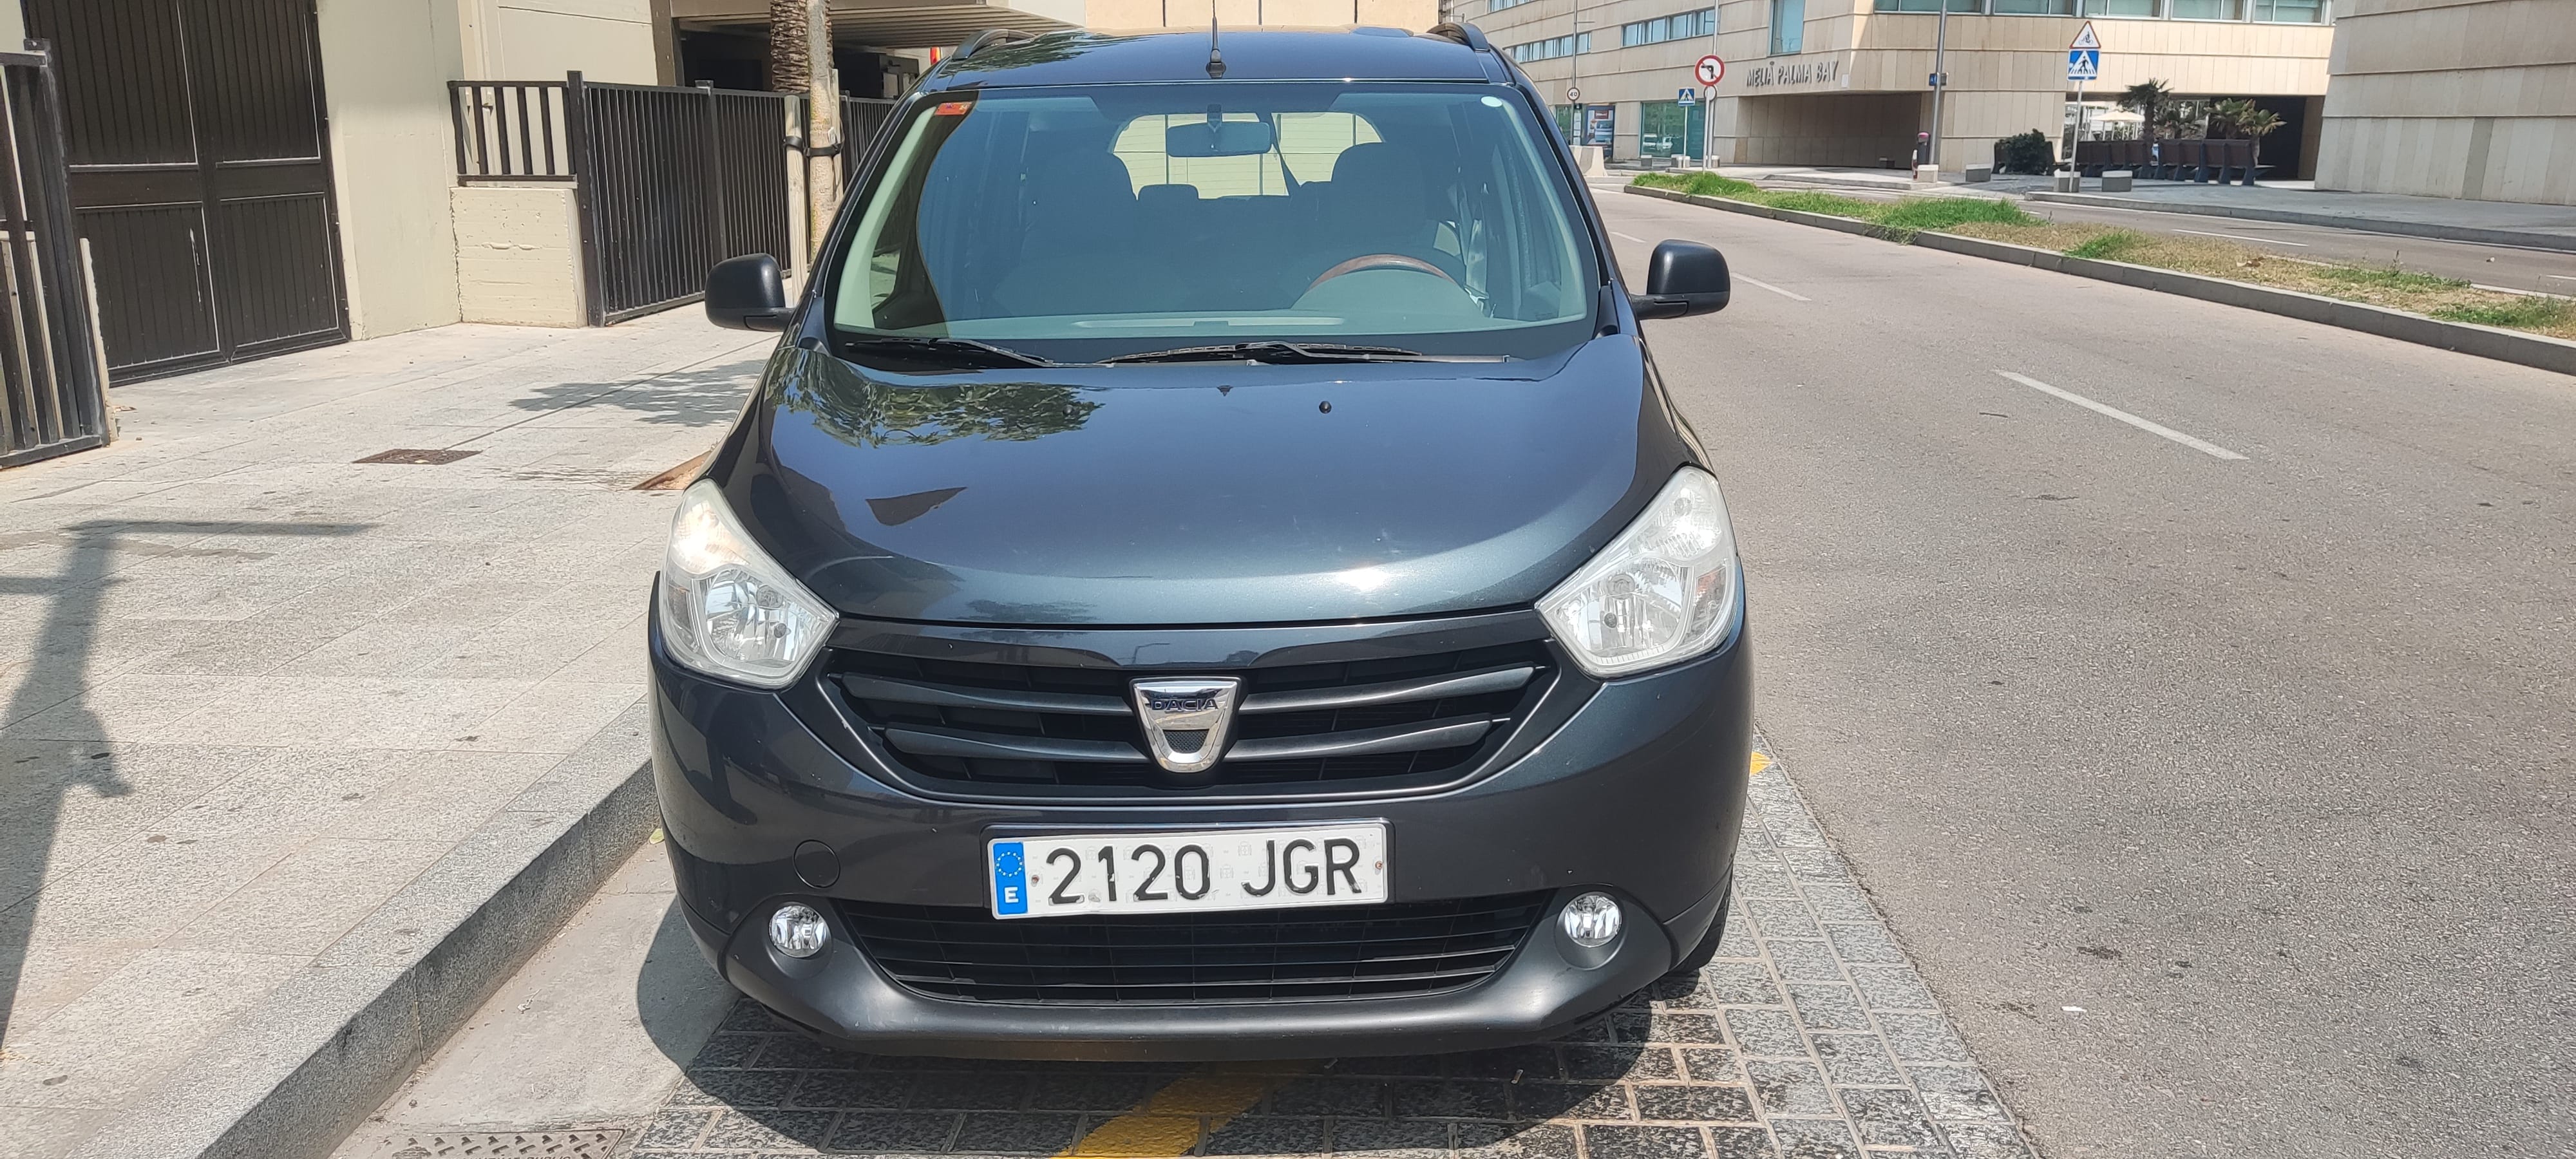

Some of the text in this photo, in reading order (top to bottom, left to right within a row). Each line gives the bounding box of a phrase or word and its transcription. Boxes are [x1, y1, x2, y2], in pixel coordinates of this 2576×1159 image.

[1777, 64, 1812, 85] PALMA
[1816, 60, 1839, 82] BAY
[1151, 699, 1218, 711] DACIA
[1046, 838, 1362, 905] 2120 JGR
[1004, 886, 1019, 903] E
